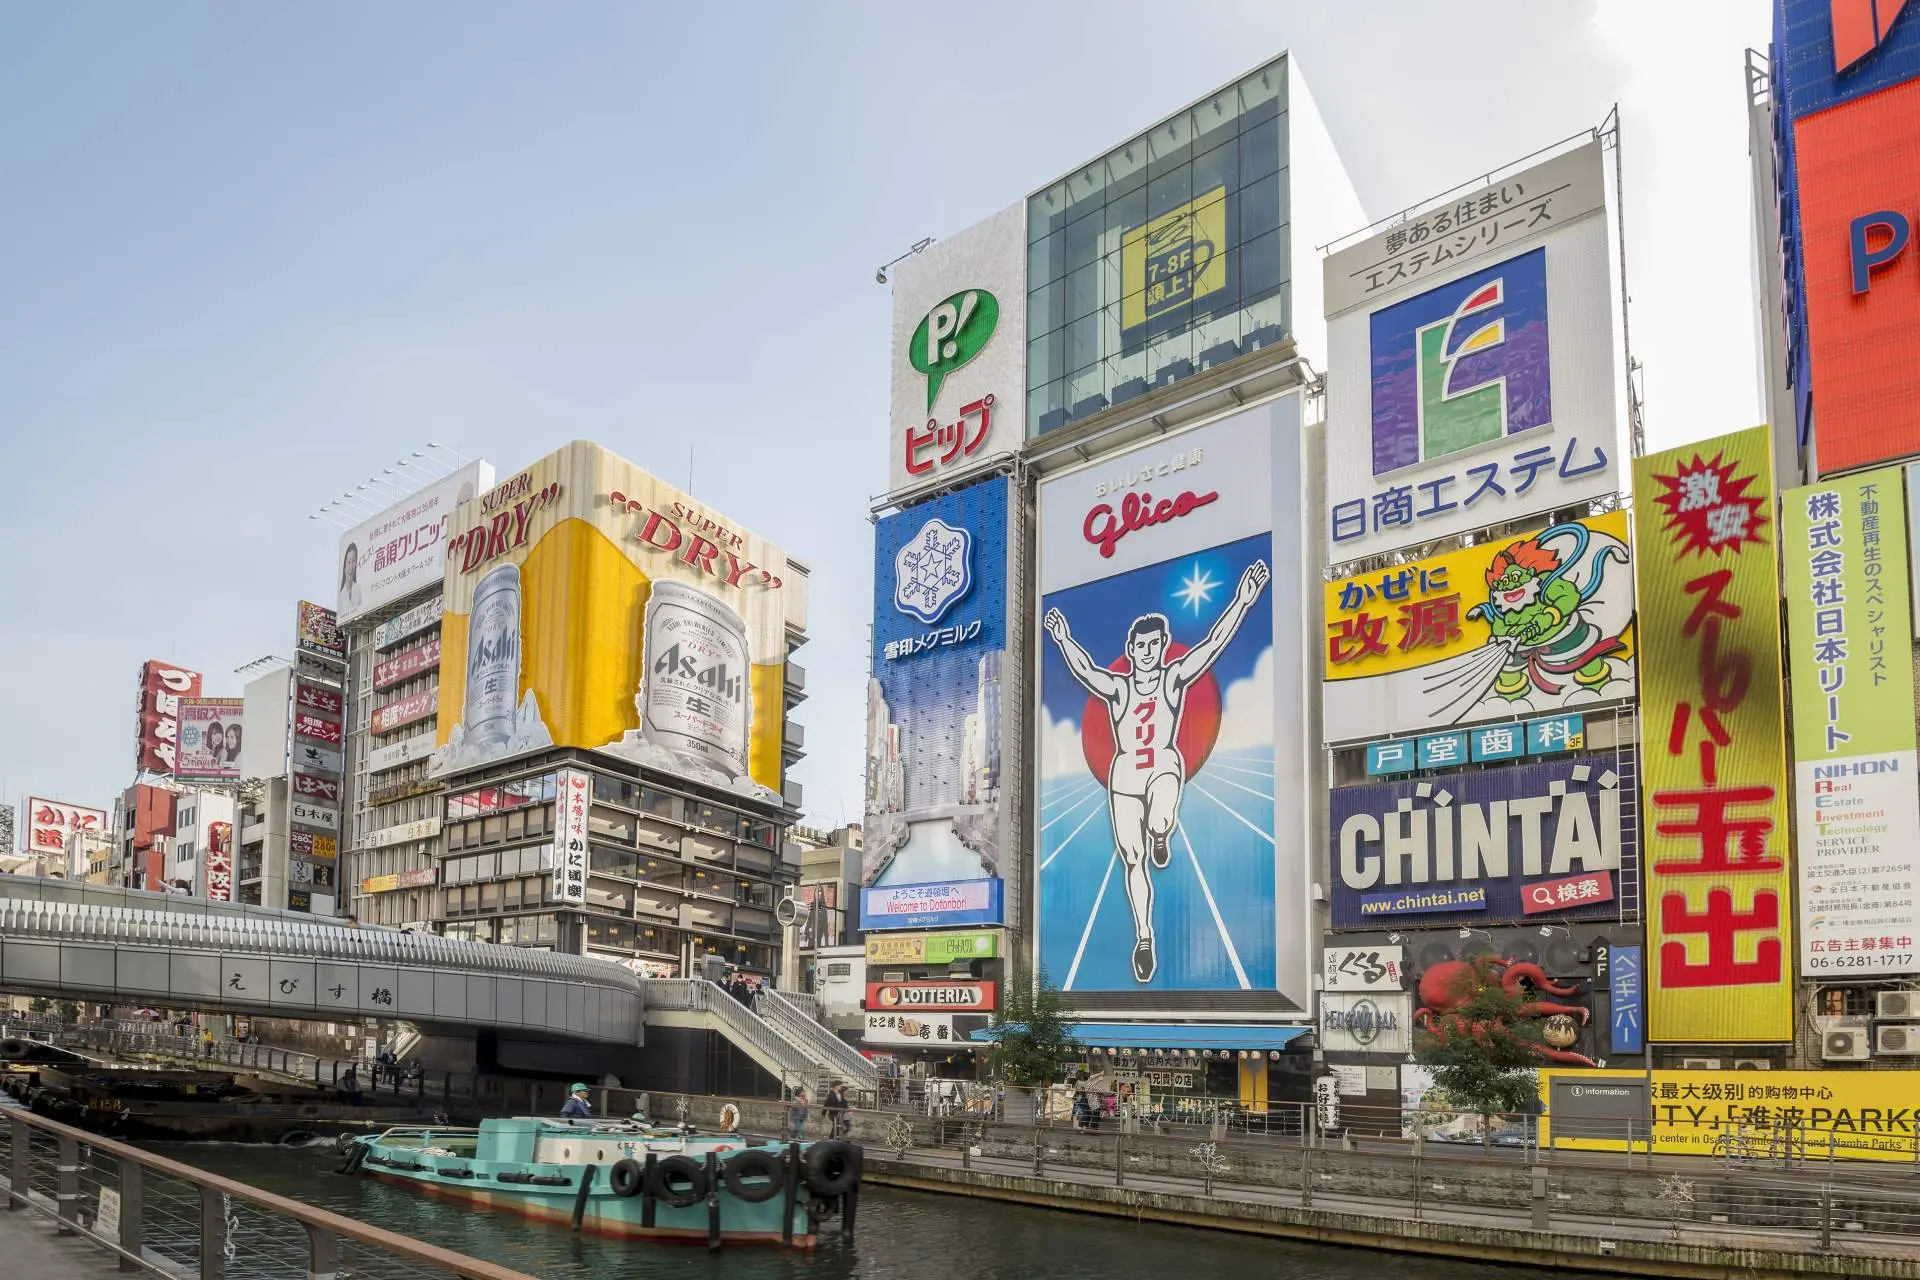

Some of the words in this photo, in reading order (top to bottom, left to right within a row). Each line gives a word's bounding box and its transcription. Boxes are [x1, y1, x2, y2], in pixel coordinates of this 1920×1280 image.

[1384, 182, 1526, 257] 夢ある住まい
[1364, 198, 1553, 294] エステムシリーズ
[905, 393, 997, 476] ピップ
[1094, 447, 1204, 497] おいしさと健康
[479, 471, 530, 516] SUPER
[1332, 436, 1609, 543] 日商エステム
[670, 502, 743, 551] SUPER
[1338, 566, 1449, 611] かぜに
[1859, 483, 1887, 688] 不動産再生のスペシャリスト
[1327, 592, 1464, 665] 改源
[1806, 491, 1852, 753] 株式会社日本リート
[883, 619, 982, 661] 雪印メグミルク
[655, 643, 741, 704] Asahi
[686, 696, 711, 718] 生
[674, 710, 723, 734] スーパードライ
[1133, 697, 1156, 771] グリコ
[686, 739, 709, 753] 350ml
[1375, 718, 1571, 770] 戸堂歯科
[1569, 736, 1581, 749] 3F
[1814, 758, 1899, 780] NIHON
[1814, 780, 1852, 794] Real
[1815, 794, 1865, 808] Estate
[294, 805, 334, 827] 白木屋
[1340, 765, 1620, 890] CHINTAI
[1814, 822, 1888, 836] Technology
[1815, 809, 1885, 823] Investment
[1816, 836, 1869, 848] SERVICE
[1816, 844, 1881, 857] PROVIDER
[886, 900, 919, 913] Welcome
[919, 900, 928, 912] to
[929, 895, 968, 912] Dotonbori
[1361, 886, 1486, 915] ww.chintai.net
[1557, 878, 1601, 904] 検索
[1810, 935, 1913, 953] 広告主募集中
[1597, 946, 1607, 977] 2F
[1810, 954, 1913, 968] 06-6281-1717
[228, 972, 393, 1006] えびす橋
[901, 988, 973, 1004] LOTTERIA
[868, 1015, 905, 1029] たこ焼き
[1584, 1086, 1630, 1097] information
[1659, 1134, 1688, 1145] center
[1691, 1133, 1700, 1144] in
